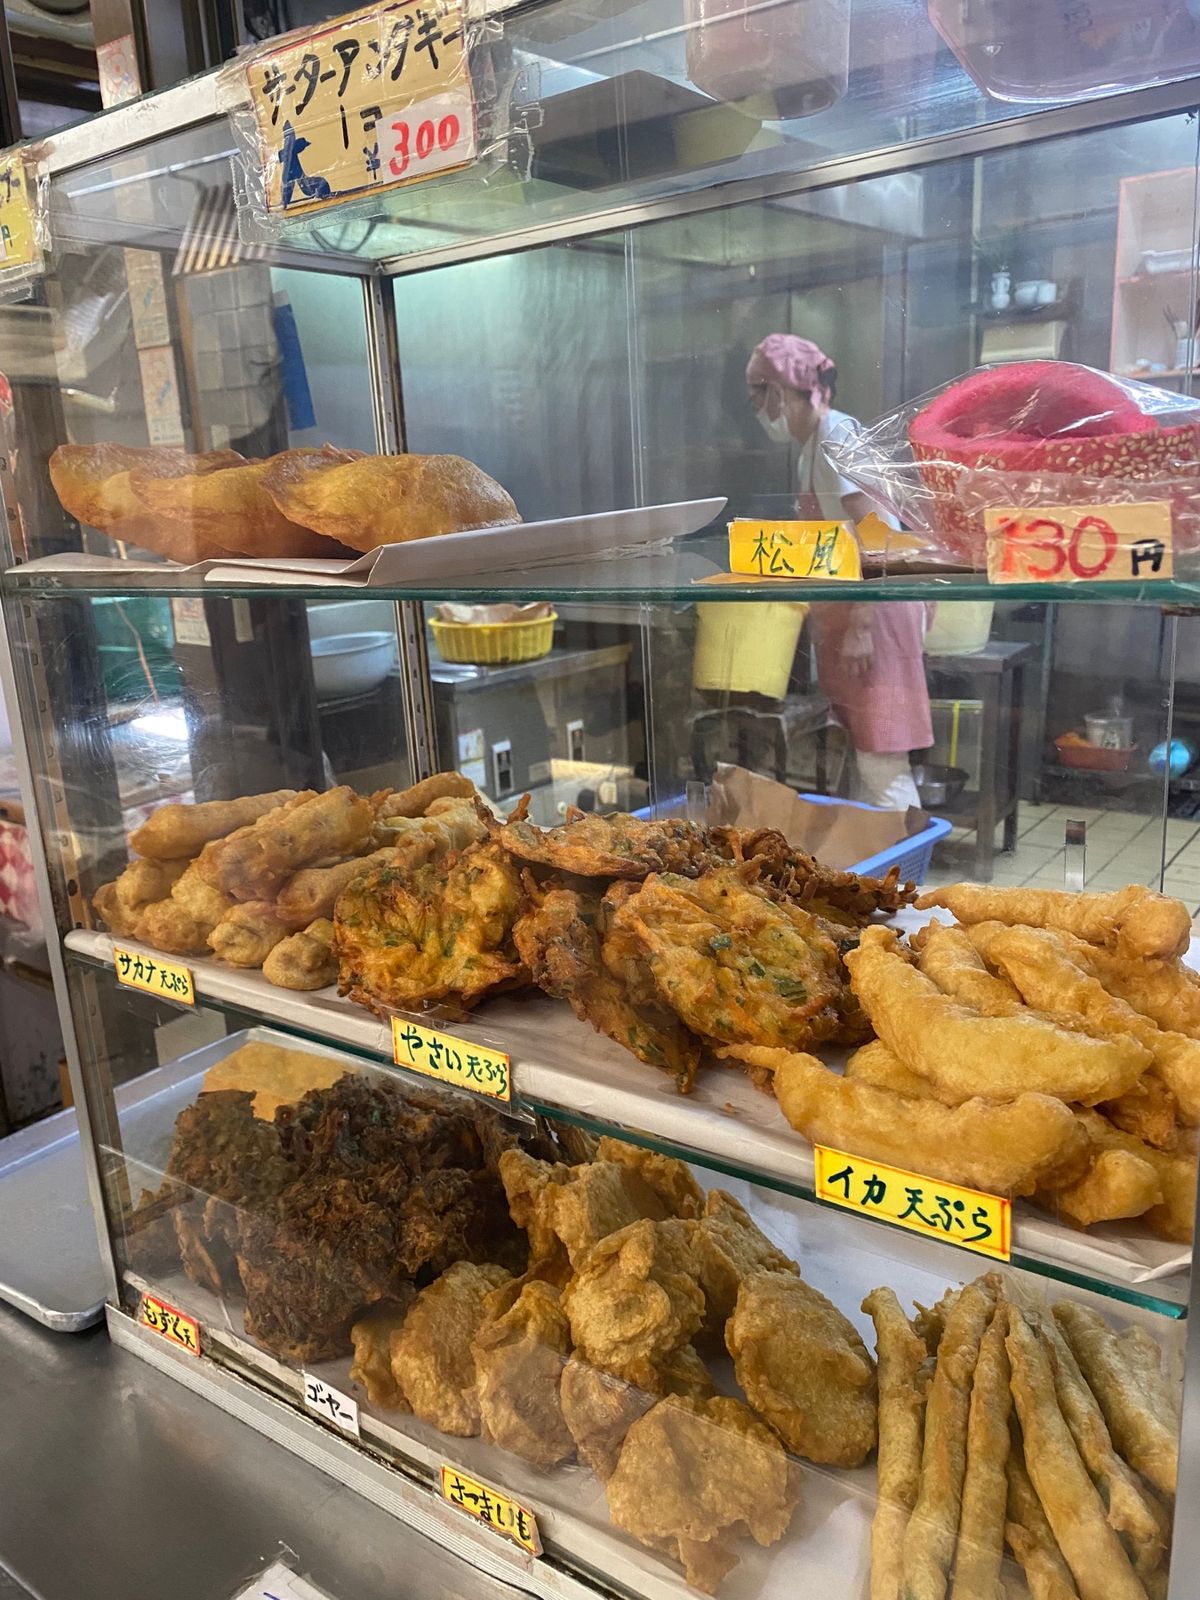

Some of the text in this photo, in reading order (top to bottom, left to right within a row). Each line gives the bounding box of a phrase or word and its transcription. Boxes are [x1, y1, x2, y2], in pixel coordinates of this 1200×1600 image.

[307, 1383, 353, 1421] ゴーヤー
[450, 1477, 531, 1540] さつまいも
